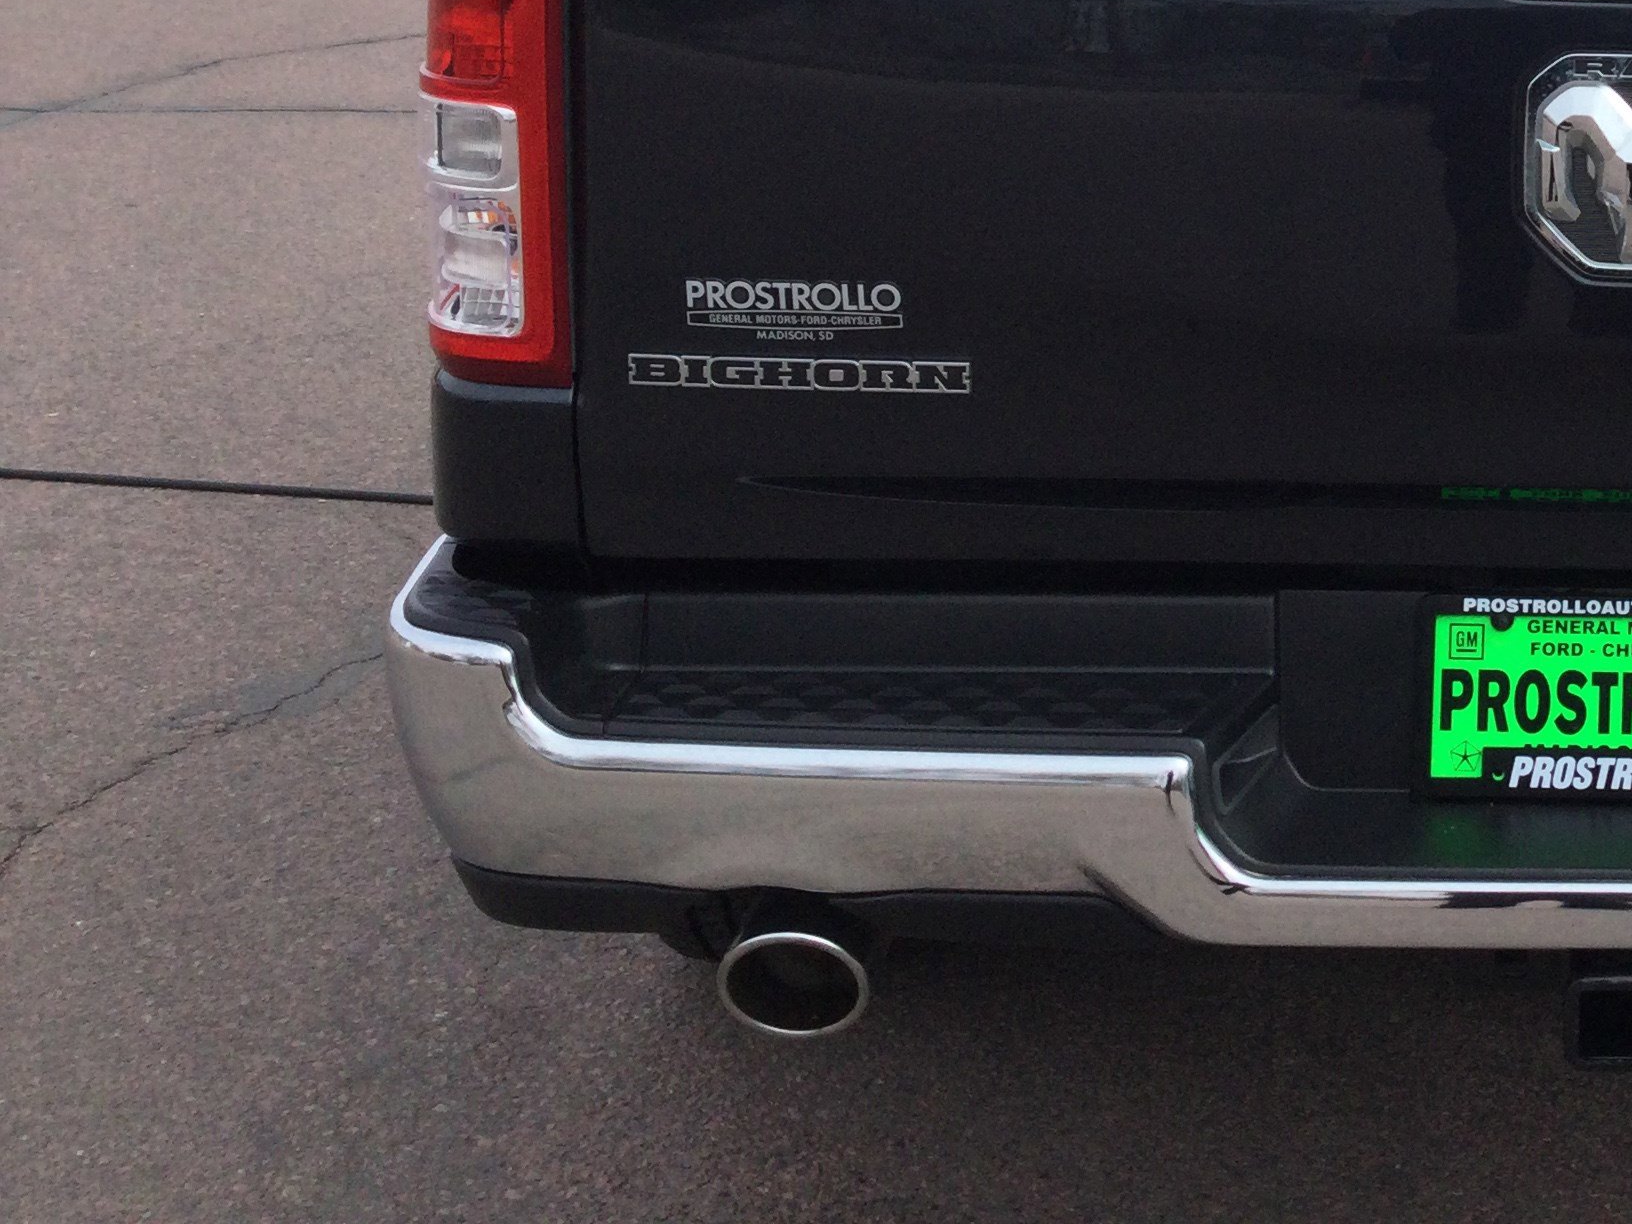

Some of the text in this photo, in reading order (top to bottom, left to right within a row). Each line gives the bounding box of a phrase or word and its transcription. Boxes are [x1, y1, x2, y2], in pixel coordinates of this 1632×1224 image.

[685, 279, 902, 311] PROSTROLLO
[709, 313, 753, 324] GENERAL
[756, 329, 834, 342] MADISON, SD
[628, 353, 971, 394] BIGHORN
[1527, 619, 1620, 636] GENERAL
[1455, 632, 1478, 649] GM
[1530, 642, 1584, 658] FORD
